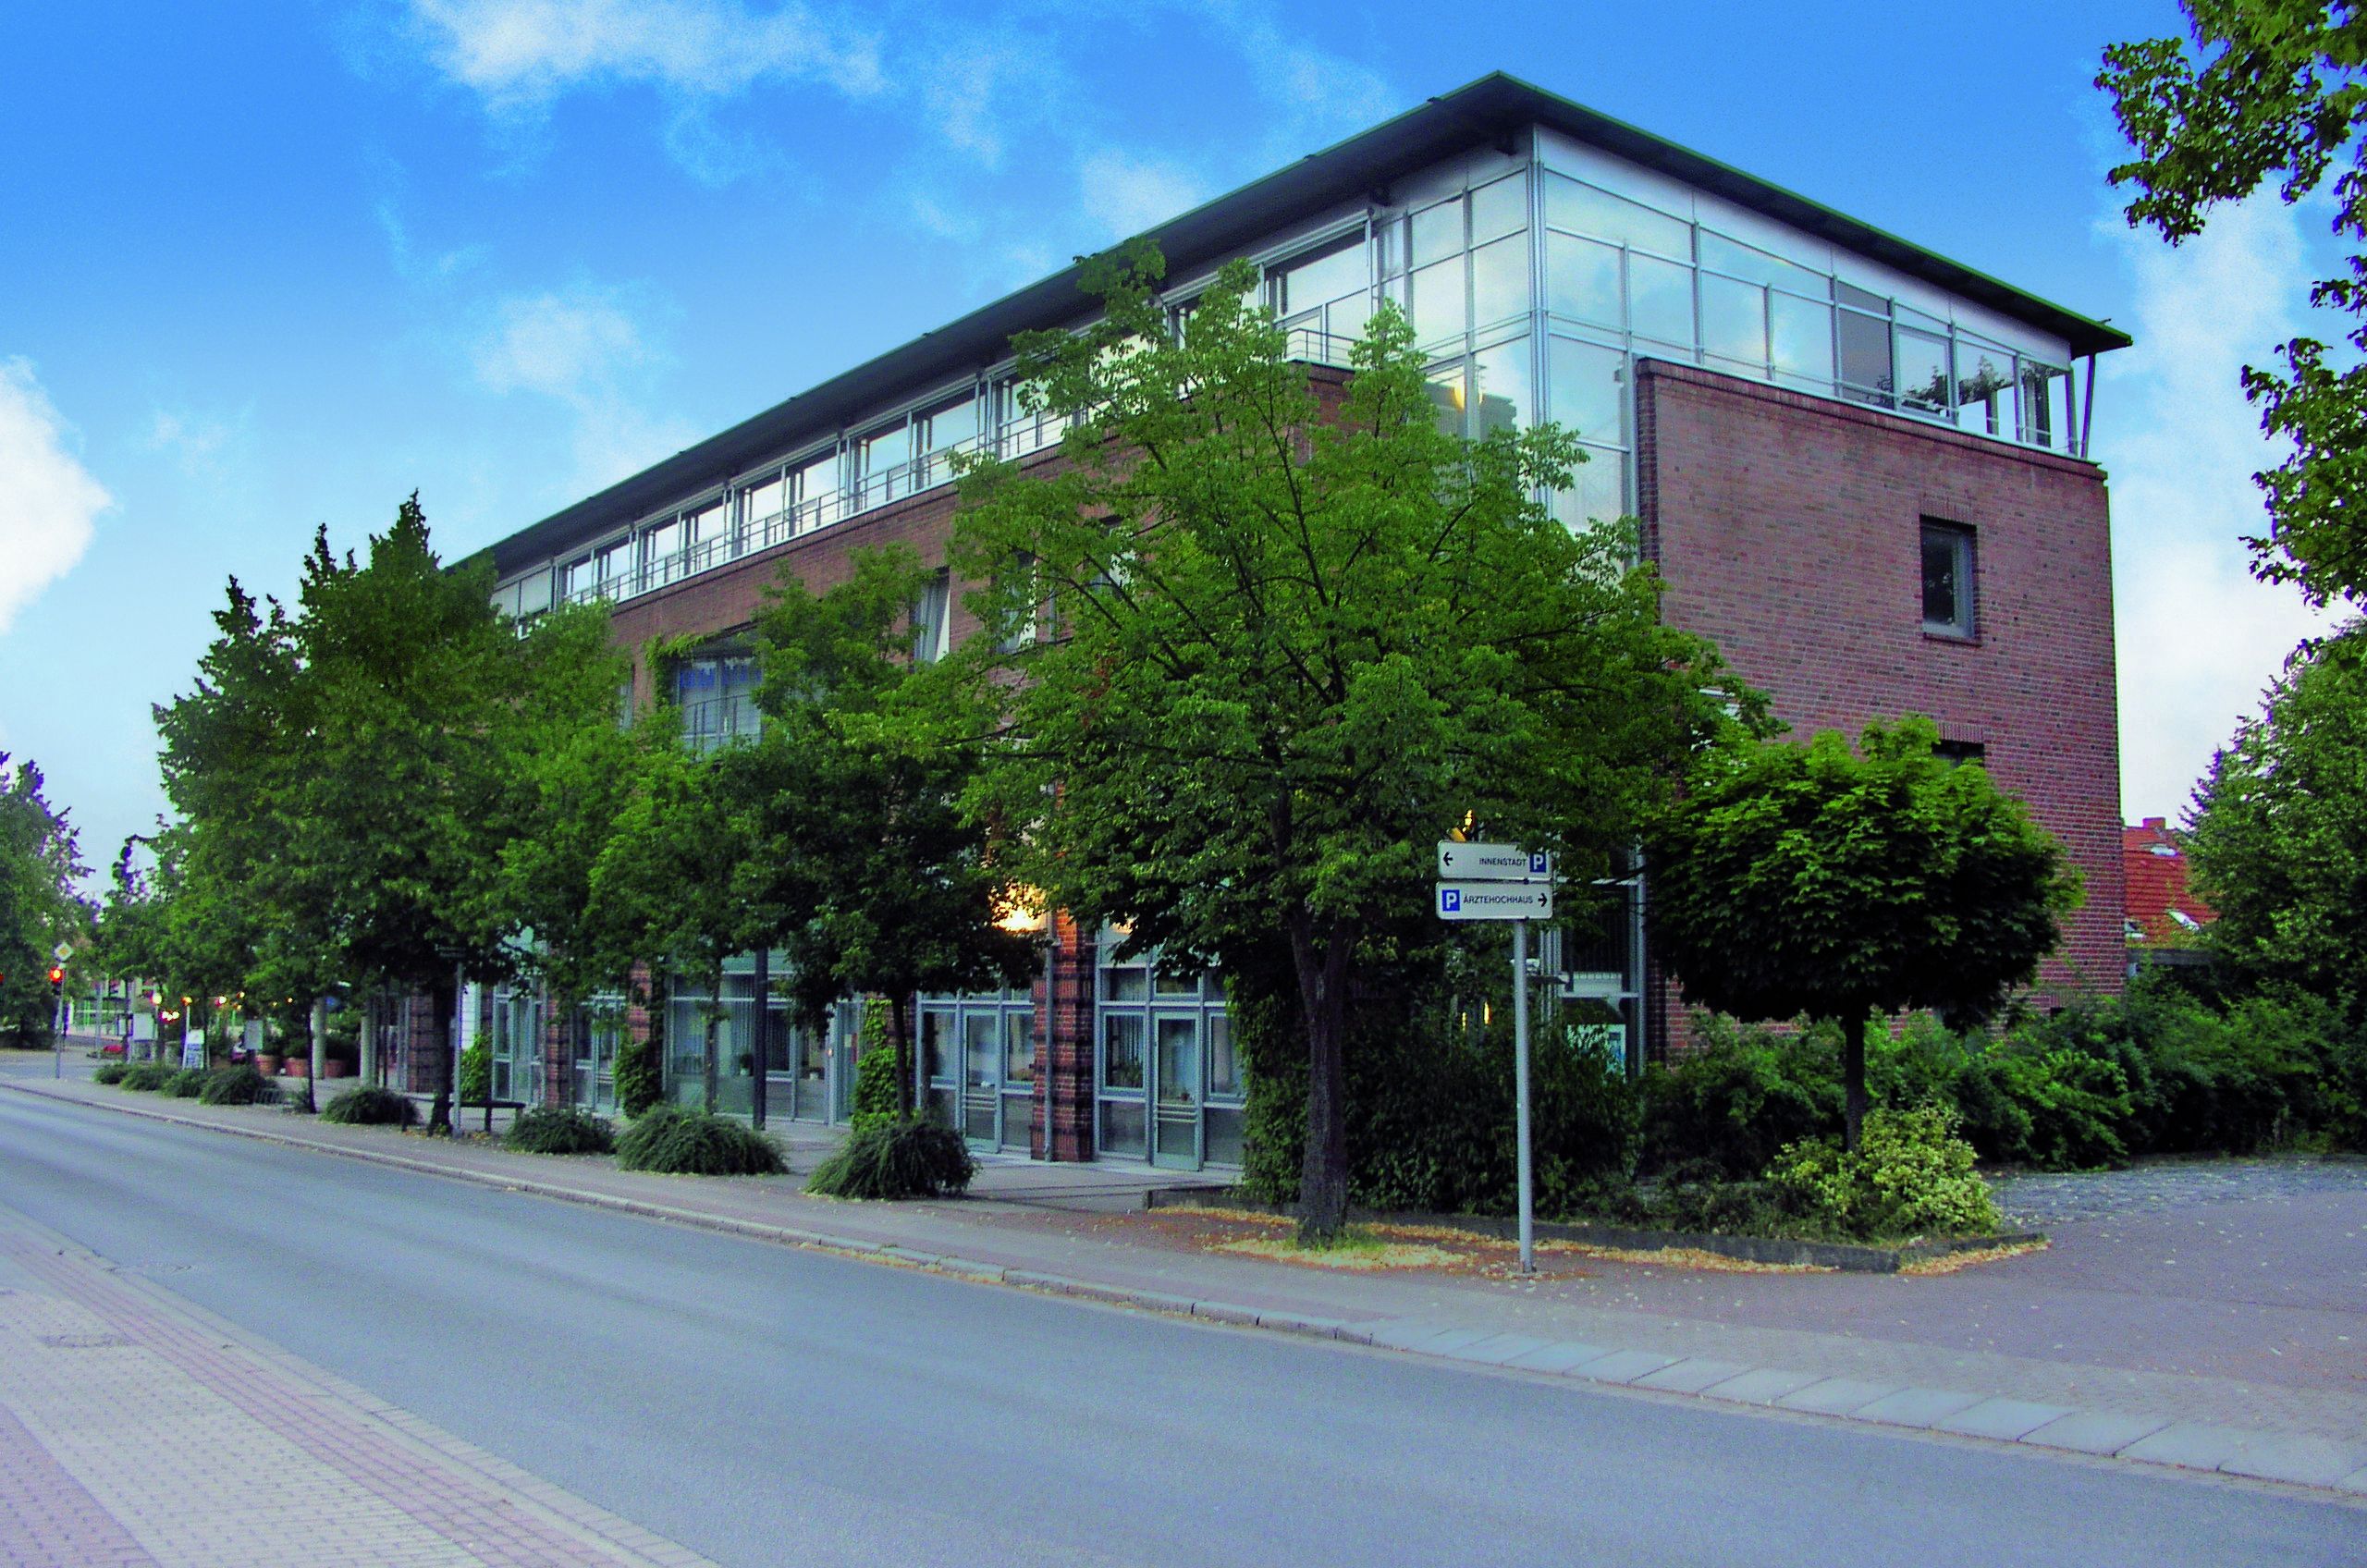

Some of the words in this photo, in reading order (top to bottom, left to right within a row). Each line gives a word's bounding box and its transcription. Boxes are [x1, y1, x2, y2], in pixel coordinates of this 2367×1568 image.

[1479, 857, 1527, 867] INNENSTADT
[1533, 853, 1543, 870] P
[1446, 891, 1457, 910] P
[1463, 893, 1534, 904] ÄRZTEHOCHHAUS
